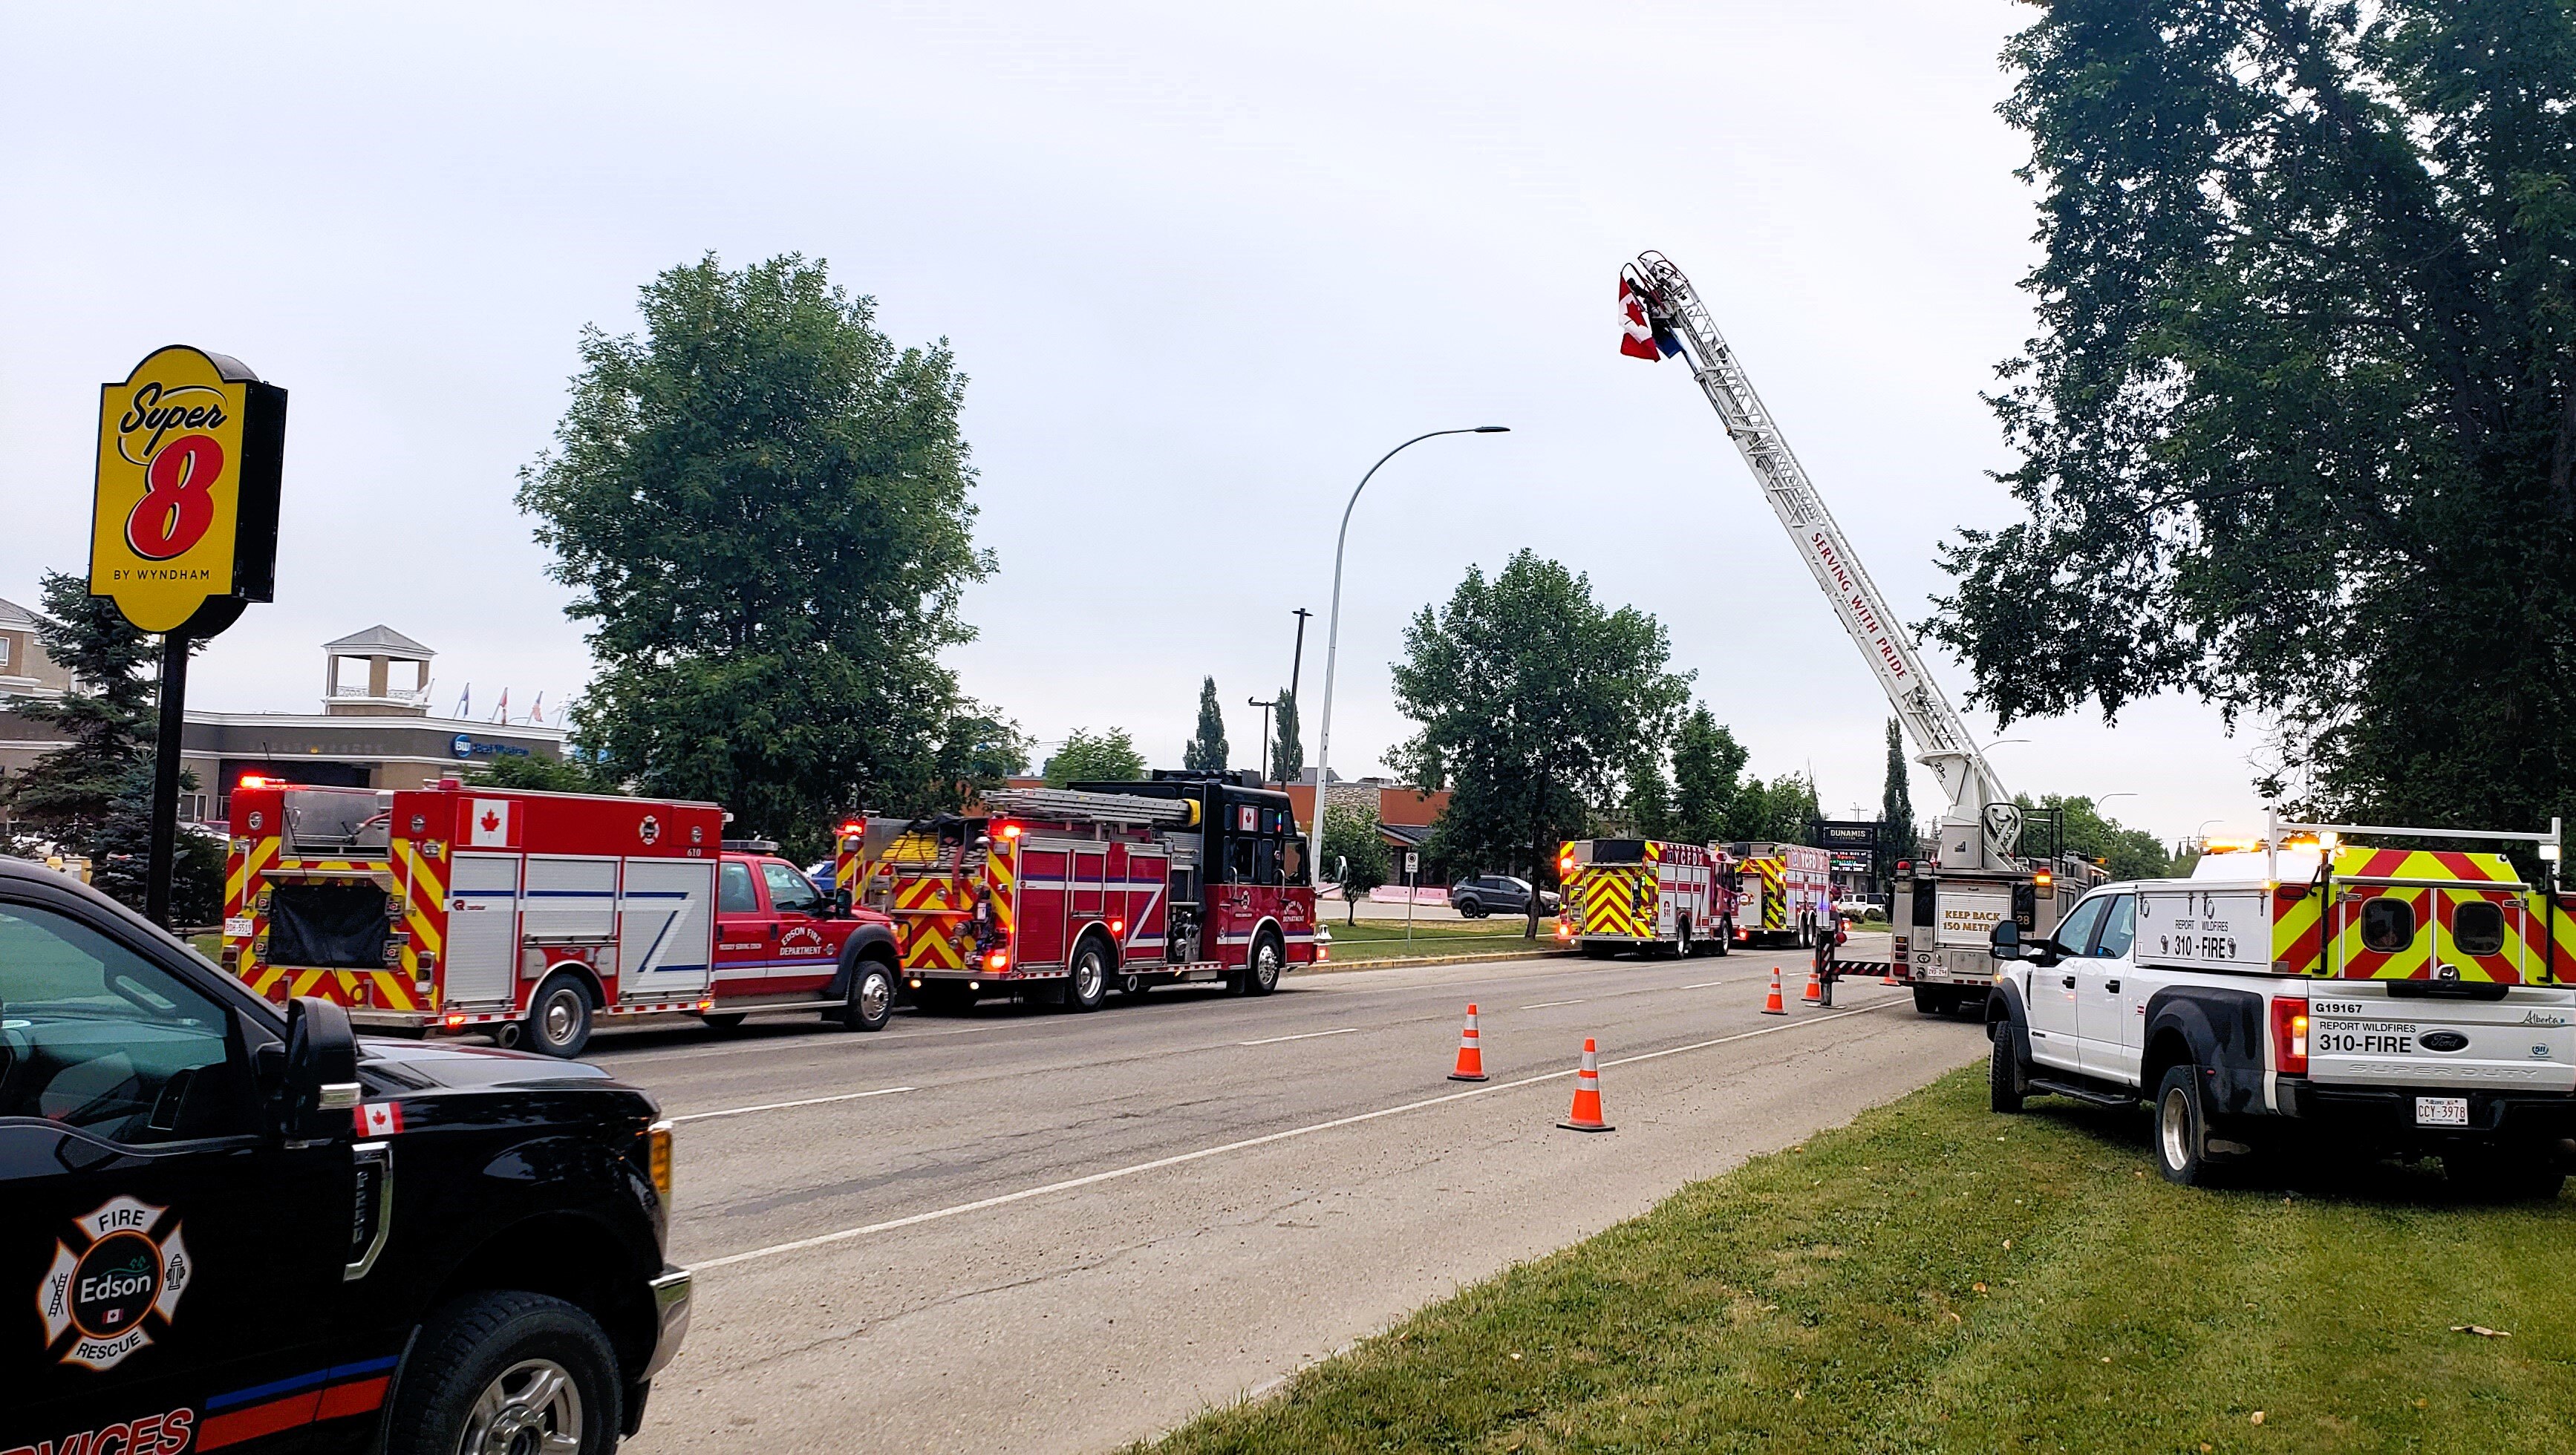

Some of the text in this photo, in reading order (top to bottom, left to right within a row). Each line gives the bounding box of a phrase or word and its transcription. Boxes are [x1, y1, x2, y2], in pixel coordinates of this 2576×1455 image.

[119, 382, 227, 457] Super
[125, 434, 224, 561] 8
[114, 570, 209, 580] BY WYNDHAM
[1811, 532, 1908, 681] SERVING WITH PRIDE
[455, 741, 471, 752] BW
[1934, 762, 1946, 779] 23m
[1830, 829, 1866, 837] DUNAMIS
[687, 848, 701, 857] 610
[1675, 849, 1698, 866] YCFD
[1801, 853, 1816, 869] YCFD
[1945, 910, 2001, 921] KEEP BACK
[2017, 915, 2029, 925] 28
[1943, 921, 1960, 930] 150
[2175, 920, 2228, 932] REPORT WILDFIRES
[781, 927, 822, 946] EDSON FIRE
[779, 946, 822, 955] DEPARTMENT
[2315, 1003, 2362, 1013] G19167
[2520, 1010, 2558, 1024] Alberta
[2320, 1021, 2416, 1033] REPORT WILDFIRES
[2319, 1033, 2412, 1053] 310-FIRE
[2431, 1035, 2457, 1047] Ford
[2349, 1064, 2537, 1079] SUPER DUTY
[2419, 1105, 2465, 1118] CCY-3978
[98, 1209, 145, 1232] FIRE
[80, 1275, 151, 1304] Edson
[76, 1331, 141, 1359] RESCUE
